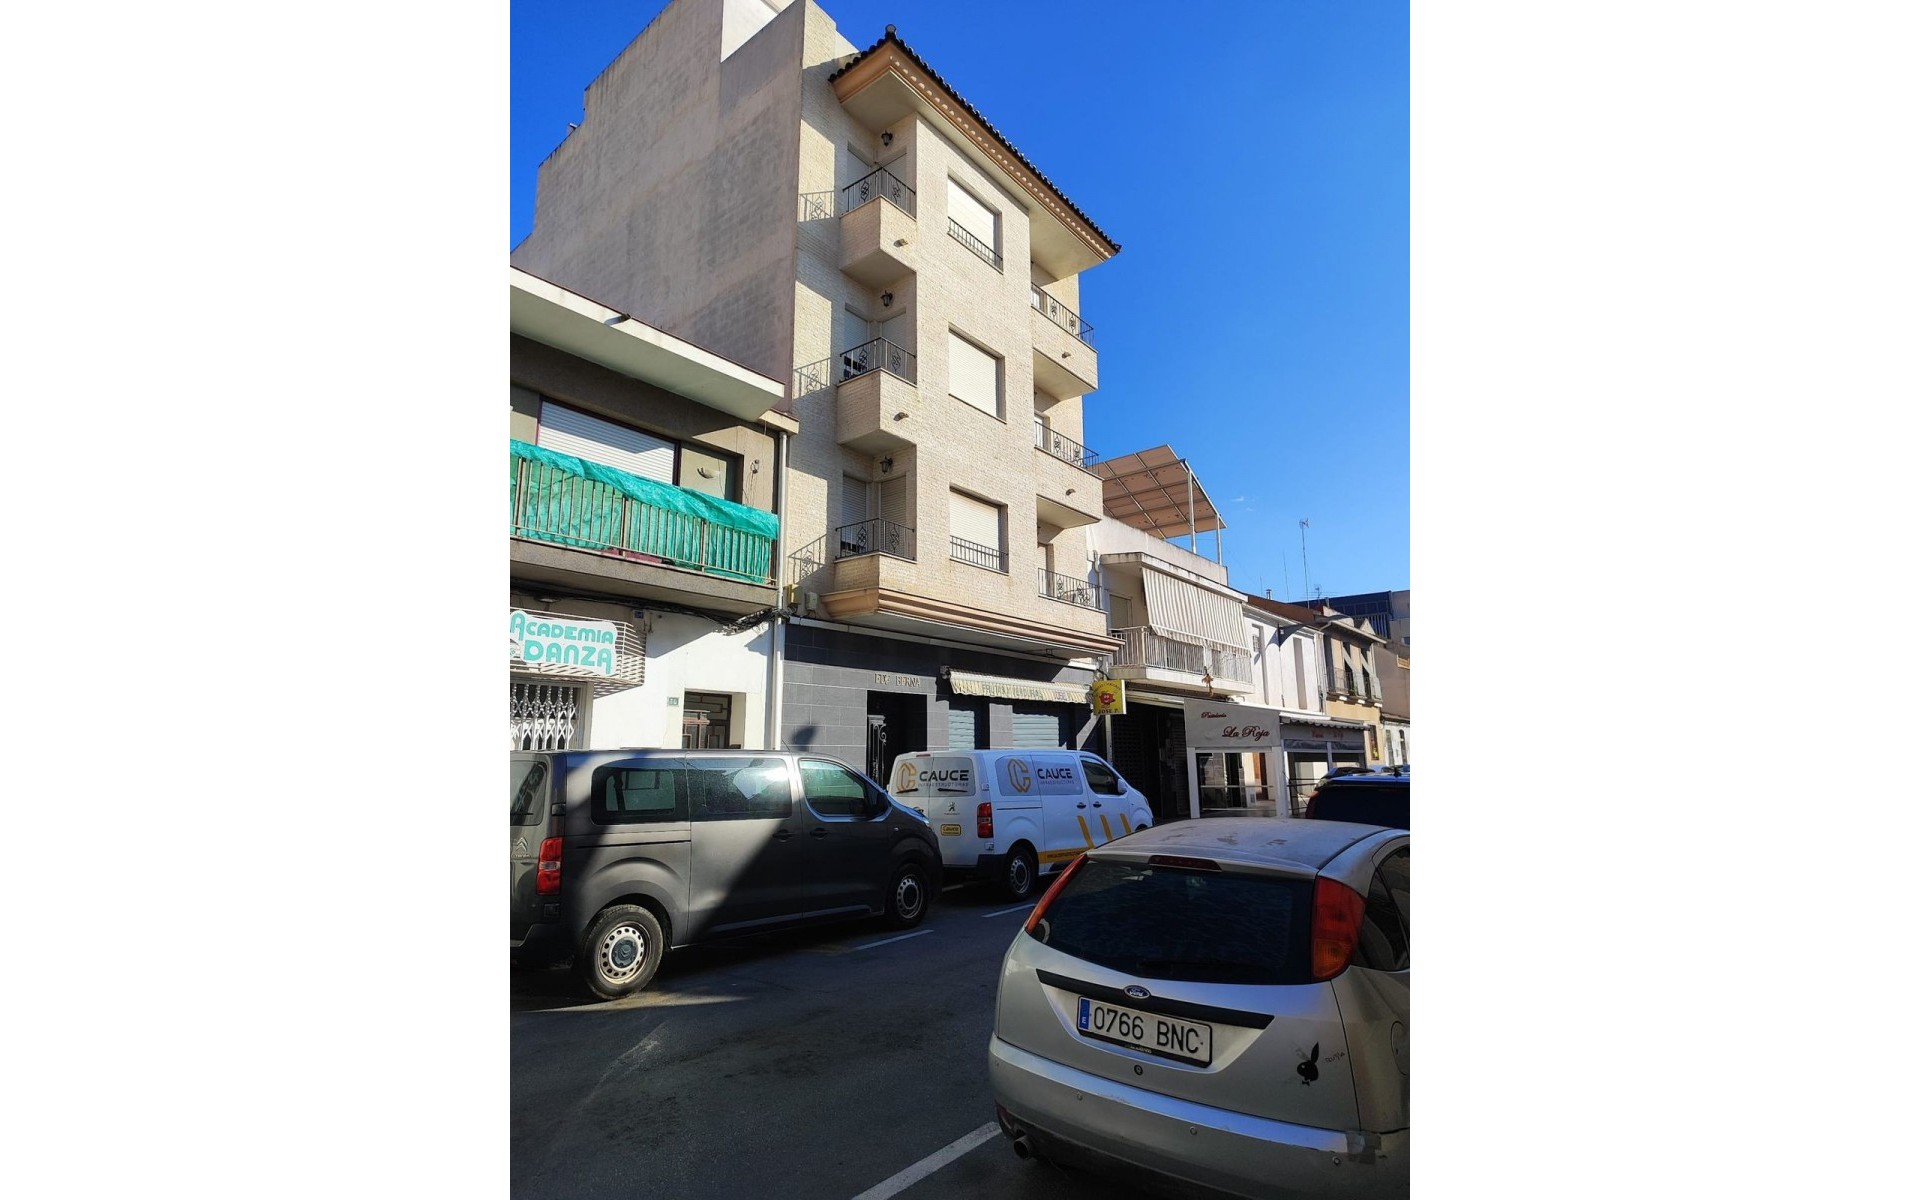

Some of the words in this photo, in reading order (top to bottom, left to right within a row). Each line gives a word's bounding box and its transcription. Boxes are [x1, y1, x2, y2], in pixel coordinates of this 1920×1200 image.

[510, 612, 614, 645] ACADEMIA
[524, 639, 613, 675] DANZA
[1222, 726, 1239, 738] La
[1242, 725, 1270, 742] Roja
[919, 769, 970, 782] CAUCE
[1037, 767, 1073, 780] CAUCE
[1093, 1006, 1144, 1040] 0766
[1156, 1020, 1200, 1054] BNC
